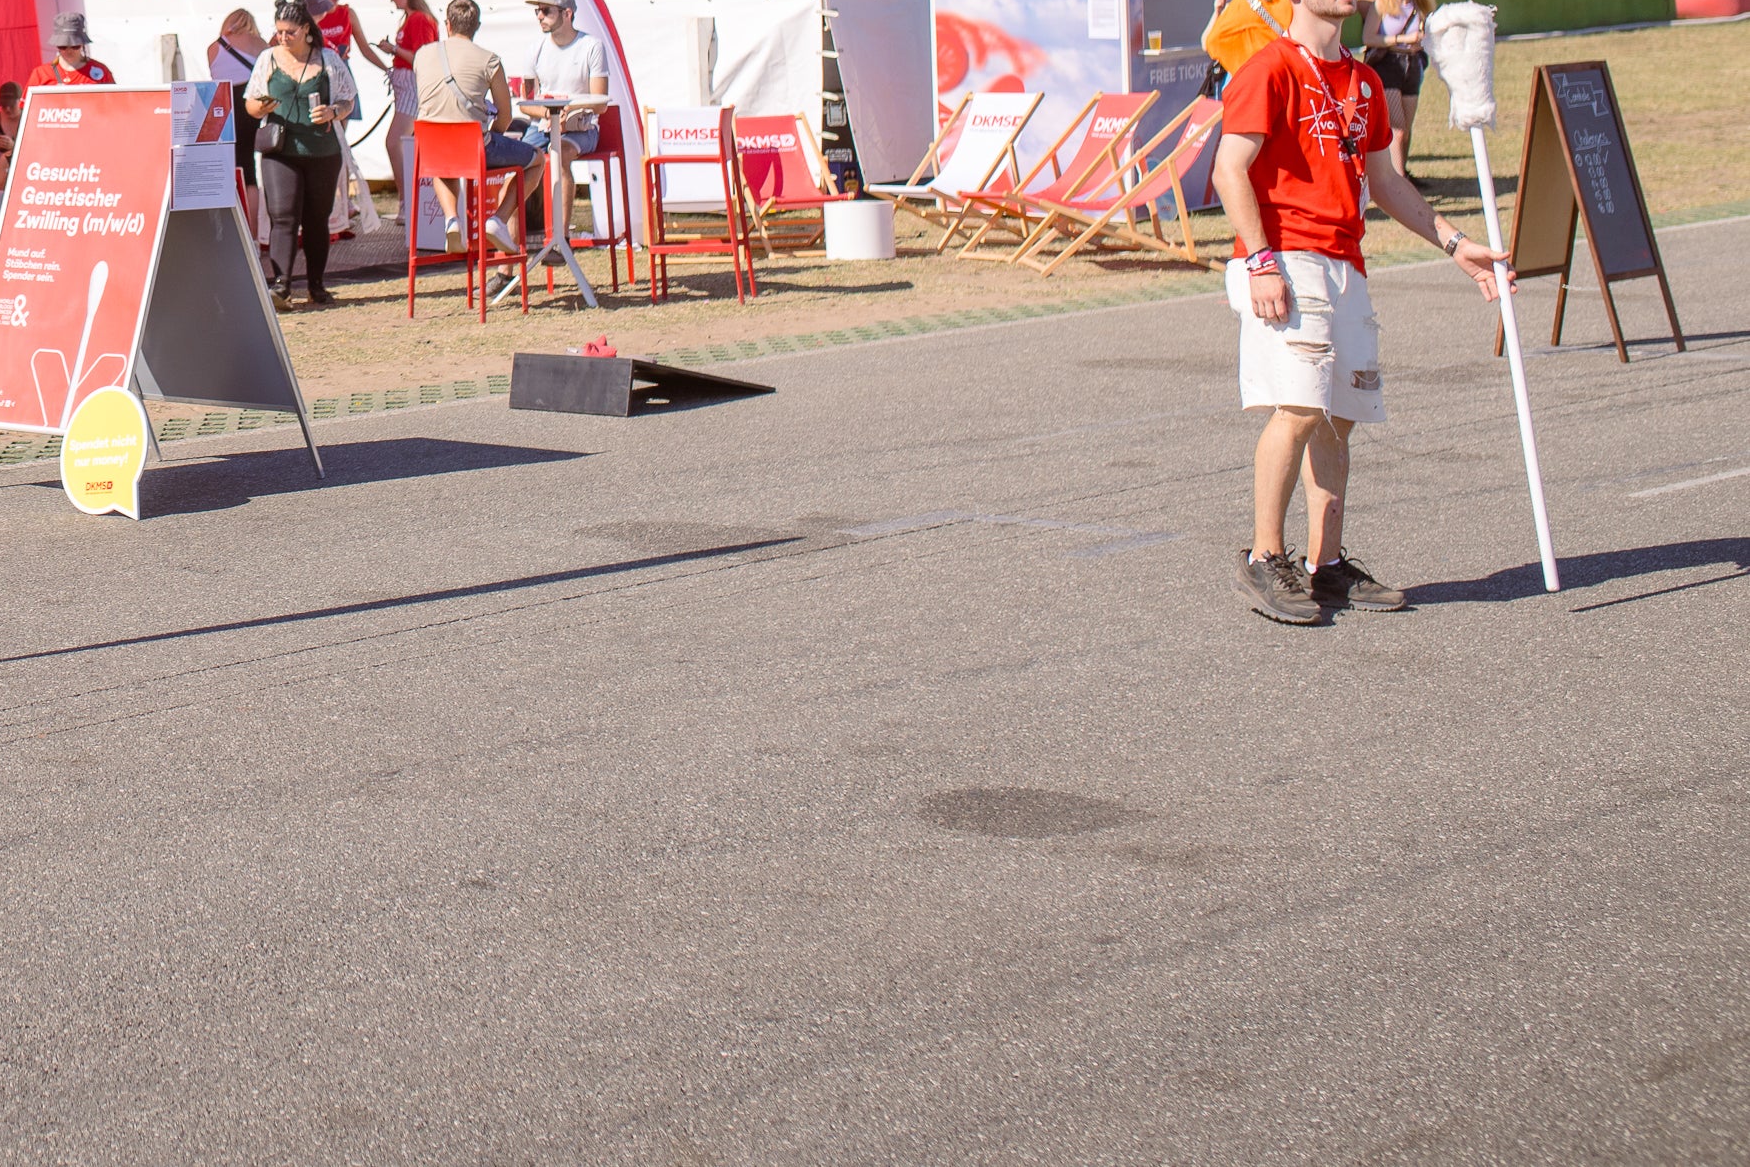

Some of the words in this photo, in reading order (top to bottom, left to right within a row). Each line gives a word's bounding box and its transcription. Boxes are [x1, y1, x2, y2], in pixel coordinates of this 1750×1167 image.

[1150, 66, 1176, 85] FREE
[37, 107, 72, 123] DKMS
[971, 114, 1013, 128] DKMS
[662, 128, 709, 140] DKMS
[26, 162, 101, 183] Gesucht:
[21, 186, 122, 208] Genetischer
[14, 210, 80, 237] Zwilling
[82, 212, 145, 237] (m/w/d)
[7, 247, 30, 258] Mund
[31, 248, 46, 259] auf.
[5, 258, 42, 271] Stäbchen
[44, 260, 61, 272] rein.
[2, 269, 35, 282] Spender
[36, 272, 54, 283] sein.
[69, 437, 110, 454] Spendet
[111, 434, 137, 448] nicht
[74, 457, 91, 467] nur
[92, 451, 129, 468] money!
[85, 481, 107, 491] DKMS
